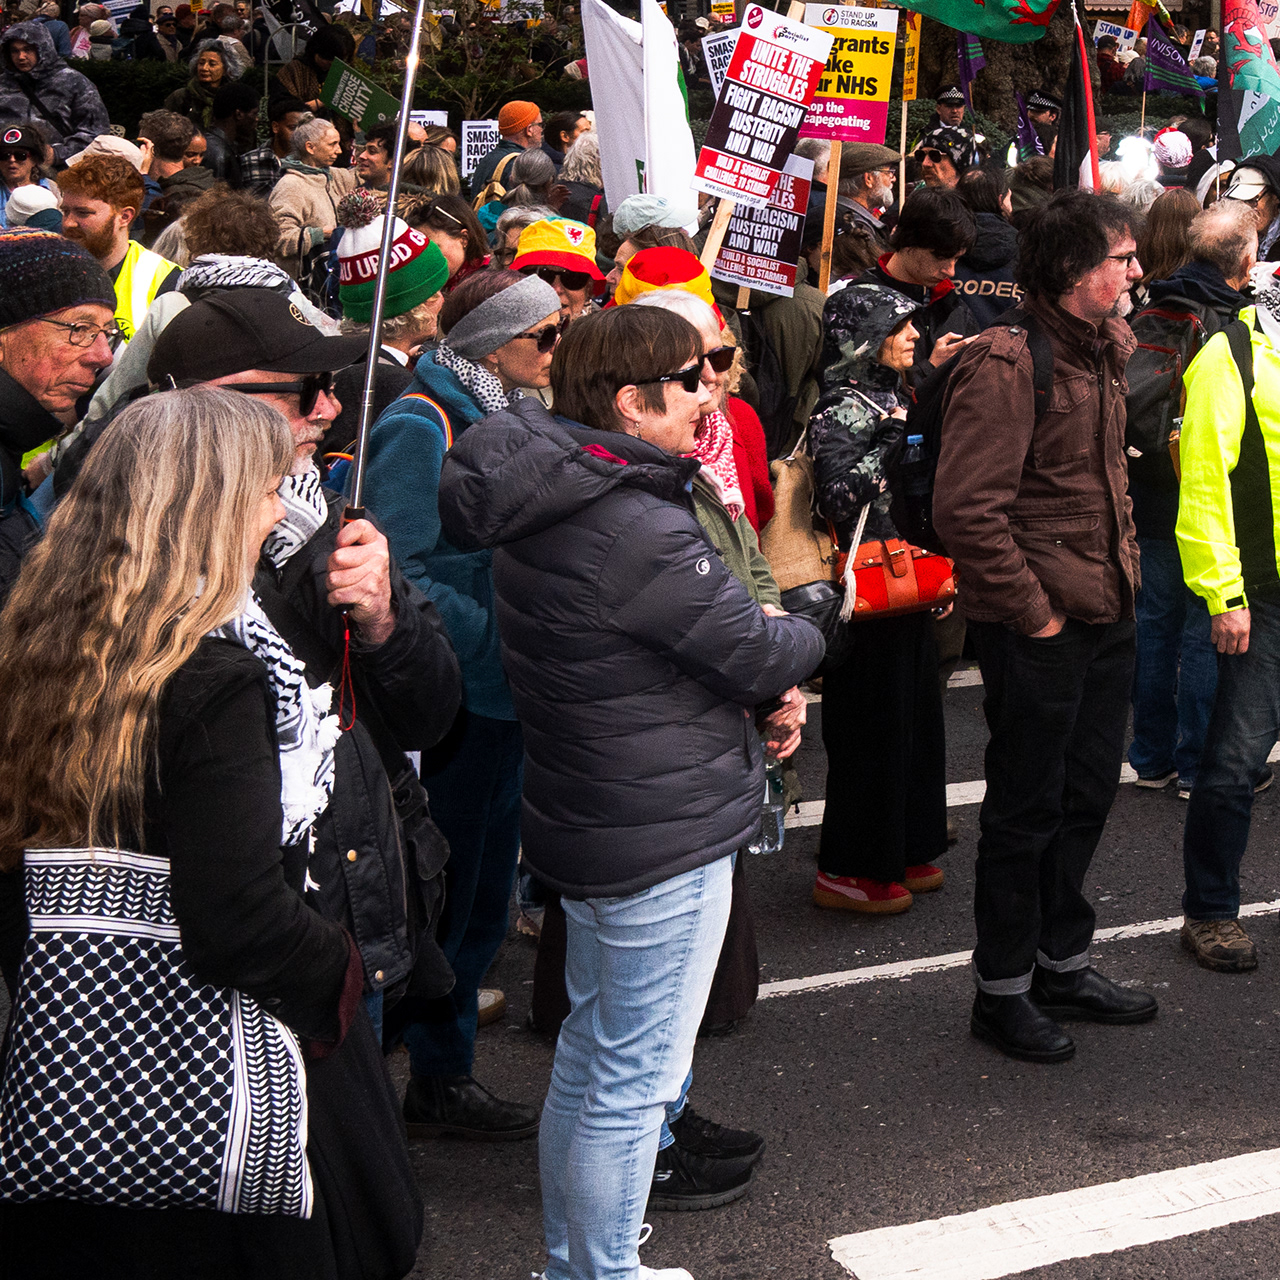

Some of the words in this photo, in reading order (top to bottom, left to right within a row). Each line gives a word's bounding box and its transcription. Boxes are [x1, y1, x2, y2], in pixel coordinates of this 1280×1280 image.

[840, 10, 865, 19] STAND
[864, 11, 876, 20] UP
[1259, 1, 1279, 18] STOP
[783, 26, 809, 43] Socialist
[840, 18, 850, 26] TO
[850, 19, 879, 28] RACISM
[1099, 22, 1122, 38] STAND
[1124, 29, 1134, 40] UP
[750, 39, 788, 72] UNITE
[789, 53, 815, 80] THE
[331, 69, 350, 108] COMMUNITIES
[739, 60, 809, 103] STRUGGLES
[836, 74, 879, 97] NHS
[338, 74, 361, 114] CHOOSE
[349, 81, 374, 122] UNITY
[724, 83, 761, 117] FIGHT
[757, 96, 804, 130] RACISM
[825, 102, 845, 114] the
[466, 131, 501, 144] SMASH
[728, 109, 787, 145] AUSTERITY
[724, 133, 751, 156] AND
[750, 140, 777, 164] WAR
[728, 218, 785, 243] AUSTERITY
[752, 206, 799, 232] RACISM
[728, 233, 754, 251] AND
[752, 240, 779, 257] WAR
[722, 249, 741, 264] BUILD
[747, 257, 780, 271] SOCIALIST
[756, 269, 788, 284] STARMER
